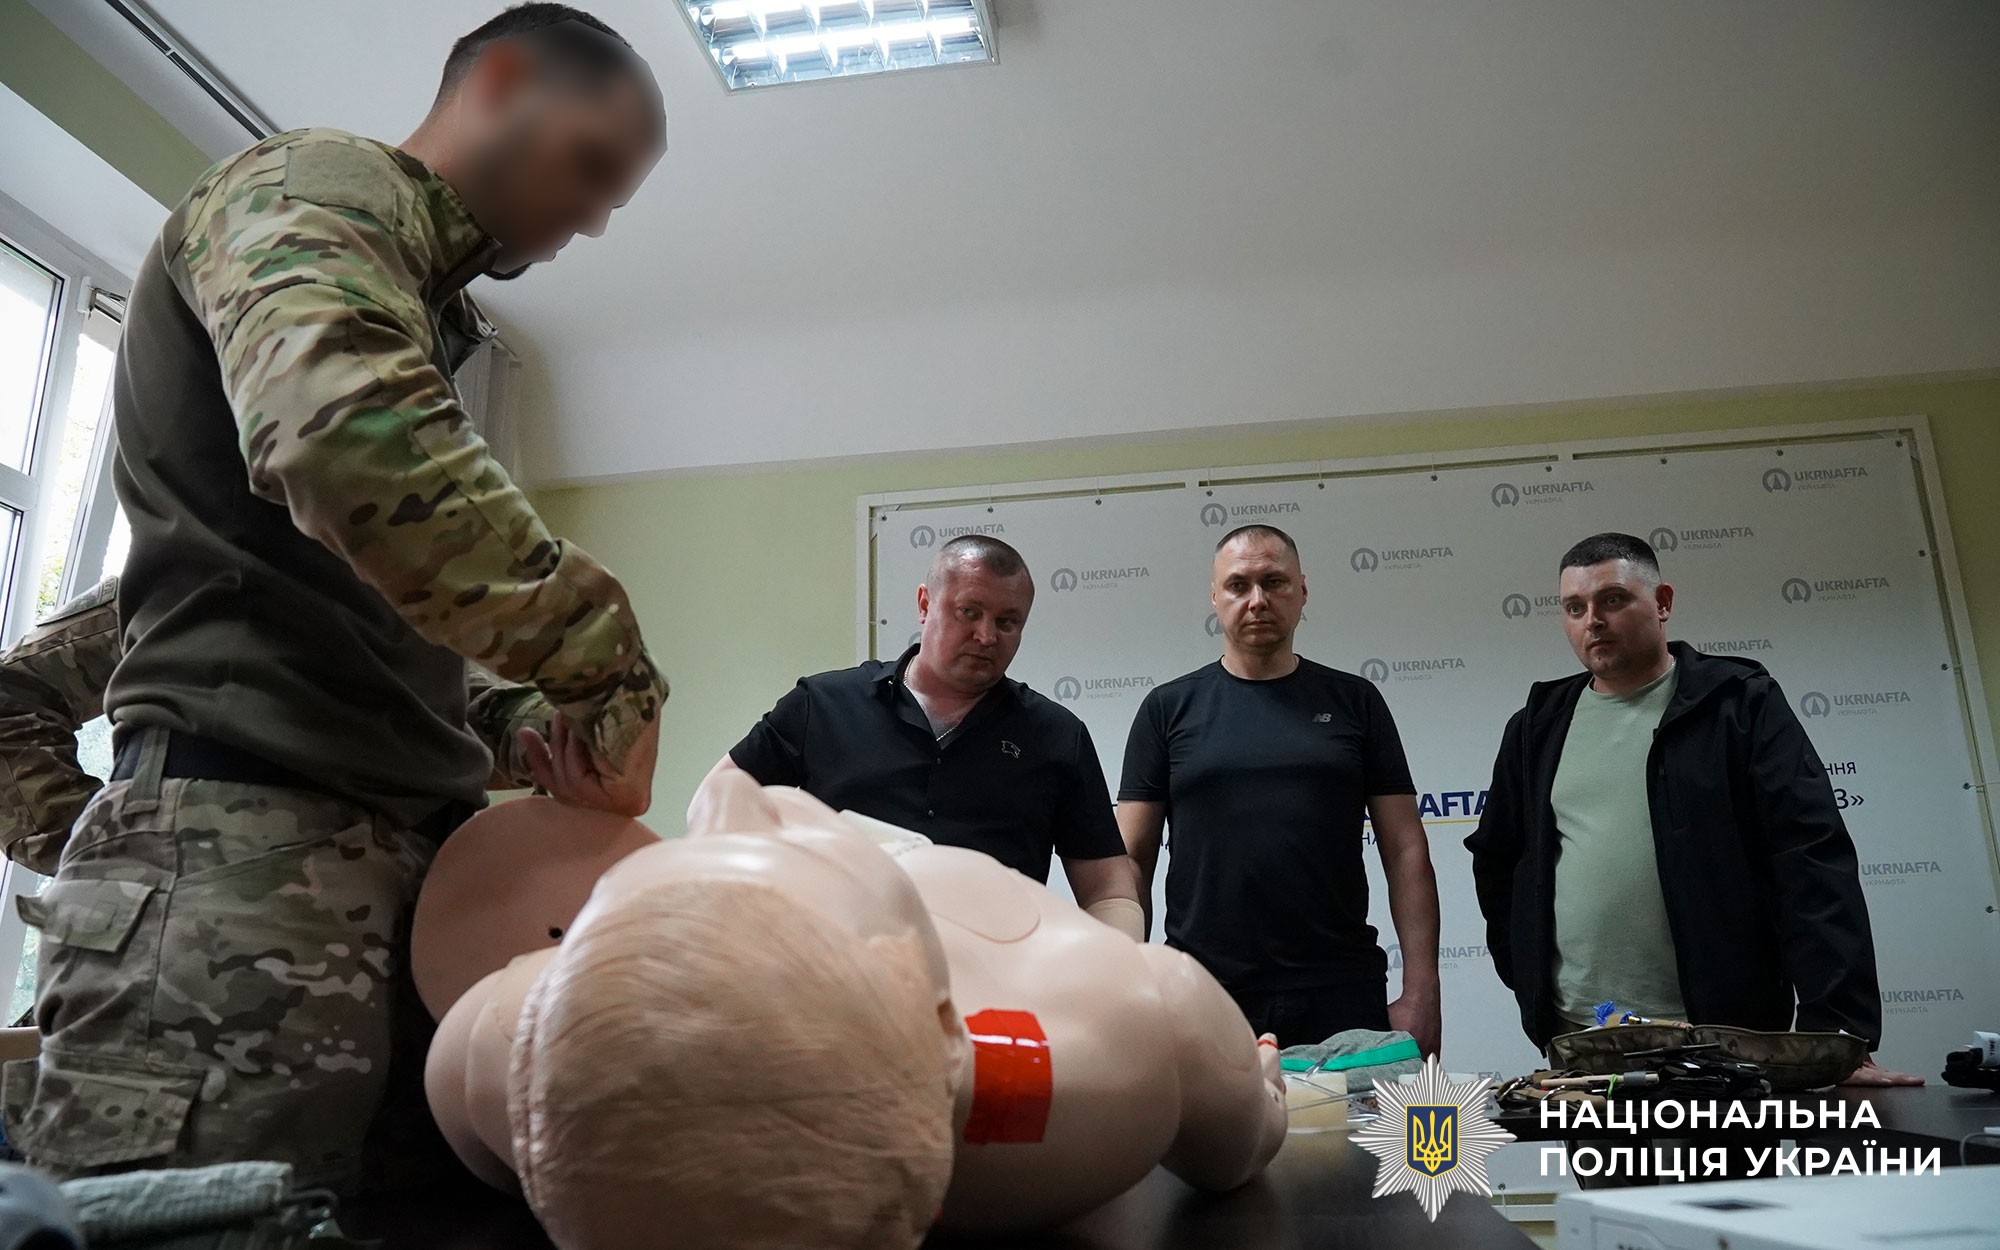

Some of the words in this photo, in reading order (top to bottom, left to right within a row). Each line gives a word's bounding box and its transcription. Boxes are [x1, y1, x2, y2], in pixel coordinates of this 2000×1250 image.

[1794, 467, 1868, 481] UKRNAFTA
[1522, 481, 1595, 496] UKRNAFTA
[1231, 502, 1300, 516] UKRNAFTA
[939, 524, 1005, 537] UKRNAFTA
[1680, 527, 1754, 541] UKRNAFTA
[1381, 547, 1454, 561] UKRNAFTA
[1081, 567, 1151, 580] UKRNAFTA
[1814, 577, 1890, 592] UKRNAFTA
[1697, 639, 1773, 653] UKRNAFTA
[1392, 658, 1466, 672] UKRNAFTA
[1085, 676, 1155, 690] UKRNAFTA
[1833, 691, 1911, 706] UKRNAFTA
[1419, 791, 1490, 818] AFTA
[1861, 861, 1942, 876] UKRNAFTA
[1440, 946, 1490, 958] RNAFTA
[1881, 989, 1964, 1003] UKRNAFTA
